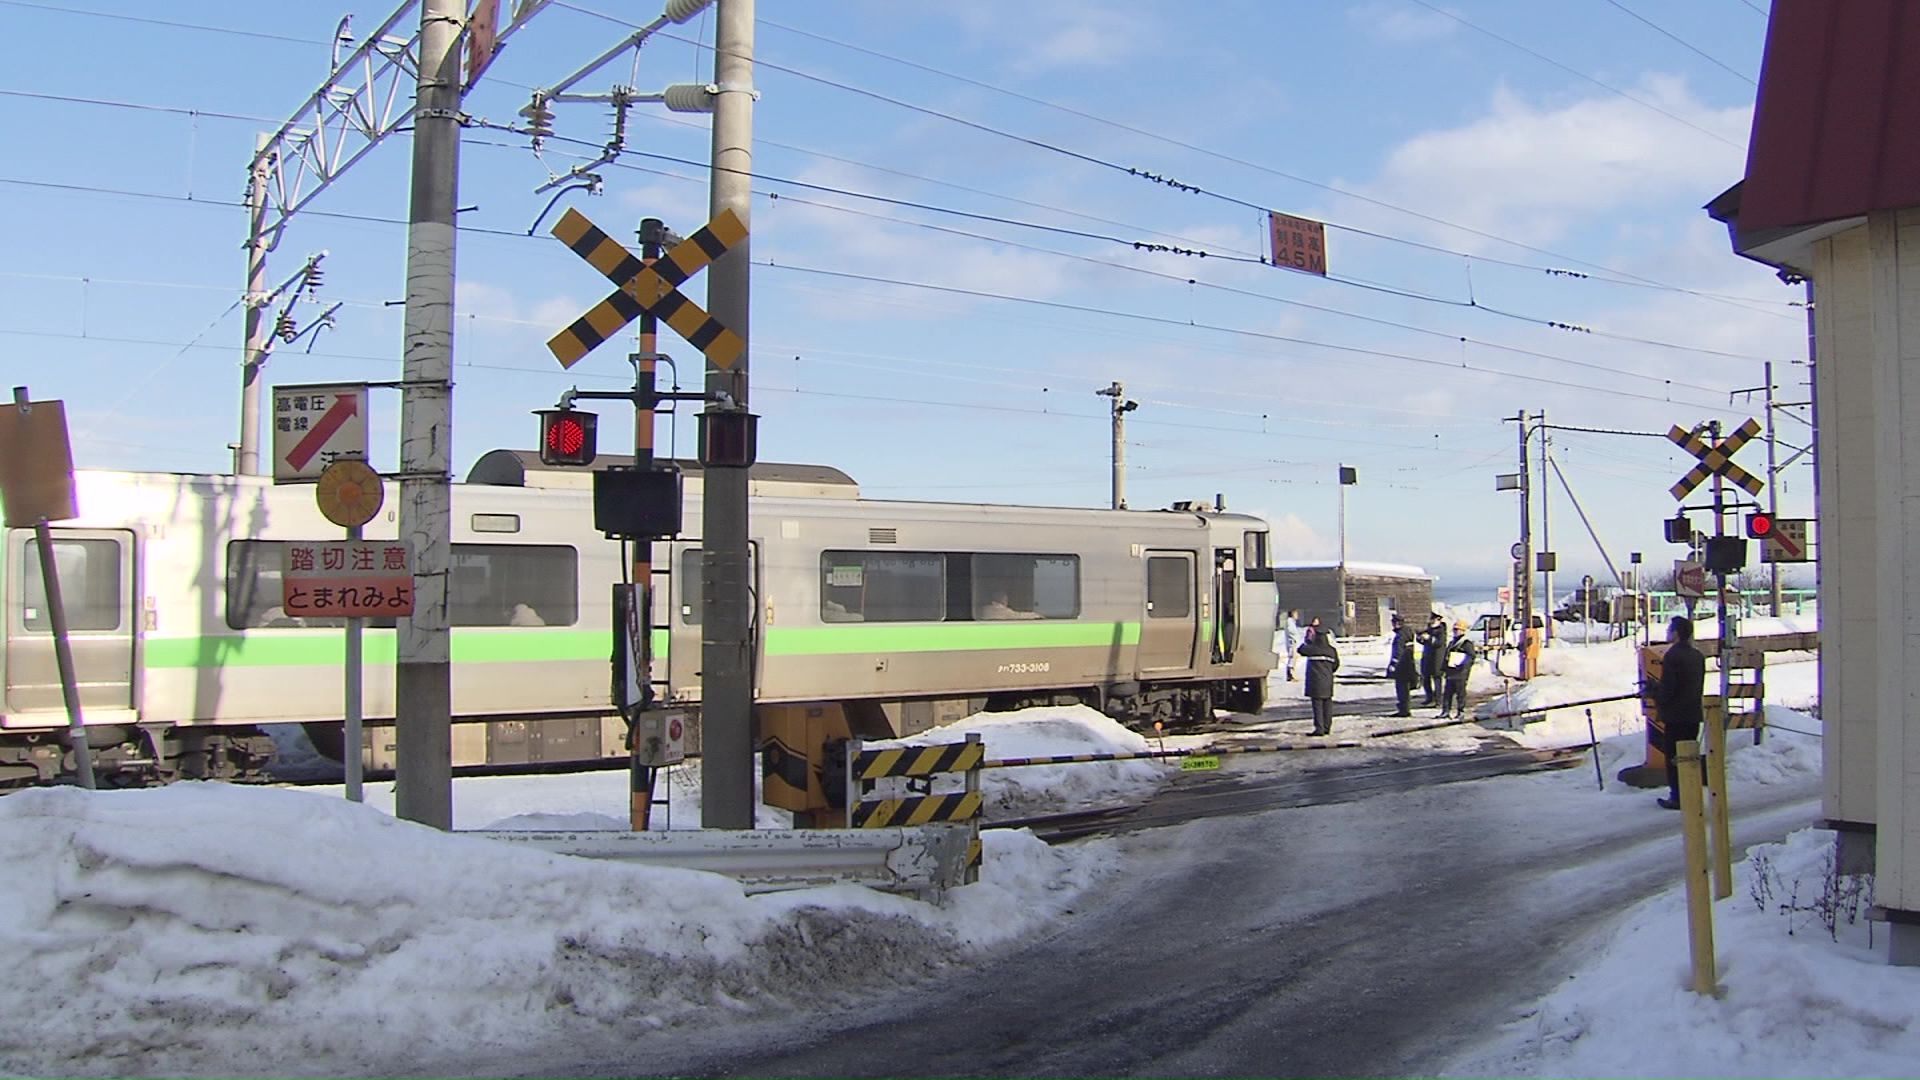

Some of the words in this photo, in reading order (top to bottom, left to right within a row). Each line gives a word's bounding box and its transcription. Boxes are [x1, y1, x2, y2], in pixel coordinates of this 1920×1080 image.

[277, 395, 326, 412] 高電圧
[277, 416, 309, 432] 電線
[290, 546, 407, 572] 踏切注意
[287, 586, 410, 609] とまれみよ
